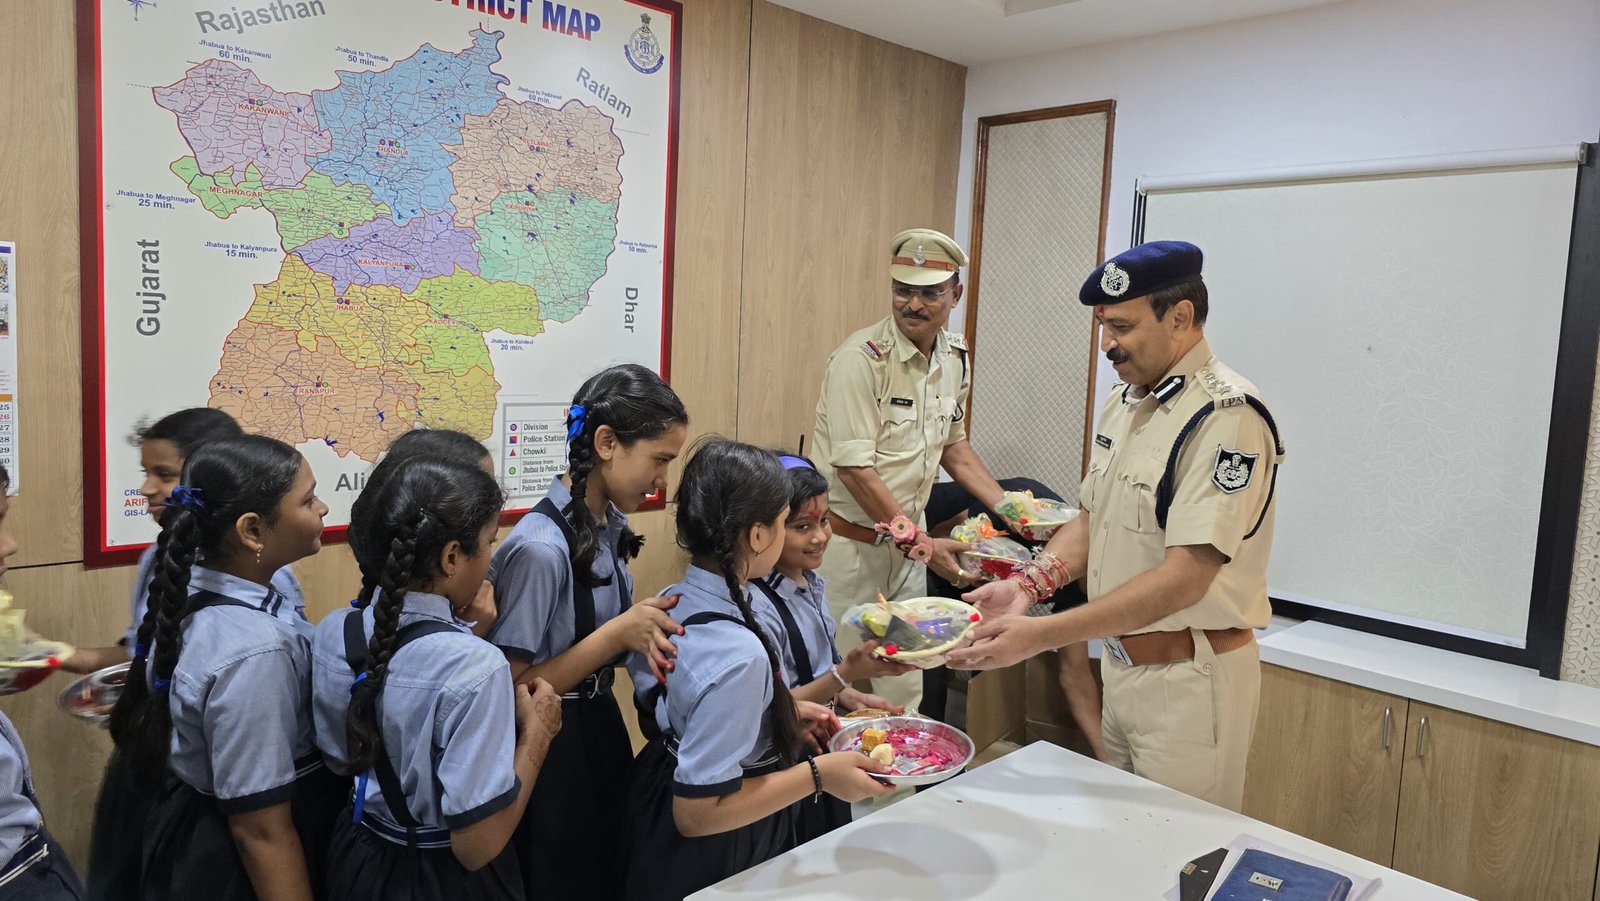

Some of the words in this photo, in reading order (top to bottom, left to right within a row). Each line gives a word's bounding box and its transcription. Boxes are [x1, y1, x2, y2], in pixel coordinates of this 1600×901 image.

[195, 0, 326, 34] Rajasthan
[542, 1, 601, 41] MAP
[198, 40, 225, 50] Jhabua
[235, 46, 272, 59] Kakanwani
[336, 46, 357, 55] Jhabua
[366, 52, 389, 62] Thandla
[219, 50, 230, 58] 60
[233, 53, 253, 63] min.
[360, 58, 377, 67] min.
[576, 67, 632, 118] Ratlam
[238, 103, 289, 116] KAKANWANI
[116, 189, 144, 198] Jhabua
[155, 193, 196, 203] Meghnagar
[209, 186, 263, 197] MEGHNAGAR
[138, 198, 151, 206] 25
[153, 200, 175, 209] min.
[204, 241, 230, 249] Jhabua
[240, 244, 278, 252] Kalyanpura
[226, 249, 237, 257] 15
[238, 251, 258, 259] min.
[136, 239, 166, 336] Gujarat
[624, 286, 639, 333] Dhar
[523, 423, 549, 431] Division
[523, 435, 543, 443] Police
[544, 434, 566, 442] Station
[523, 447, 547, 456] Chowki
[335, 472, 365, 492] Ali
[124, 509, 152, 517] GIS-LA
